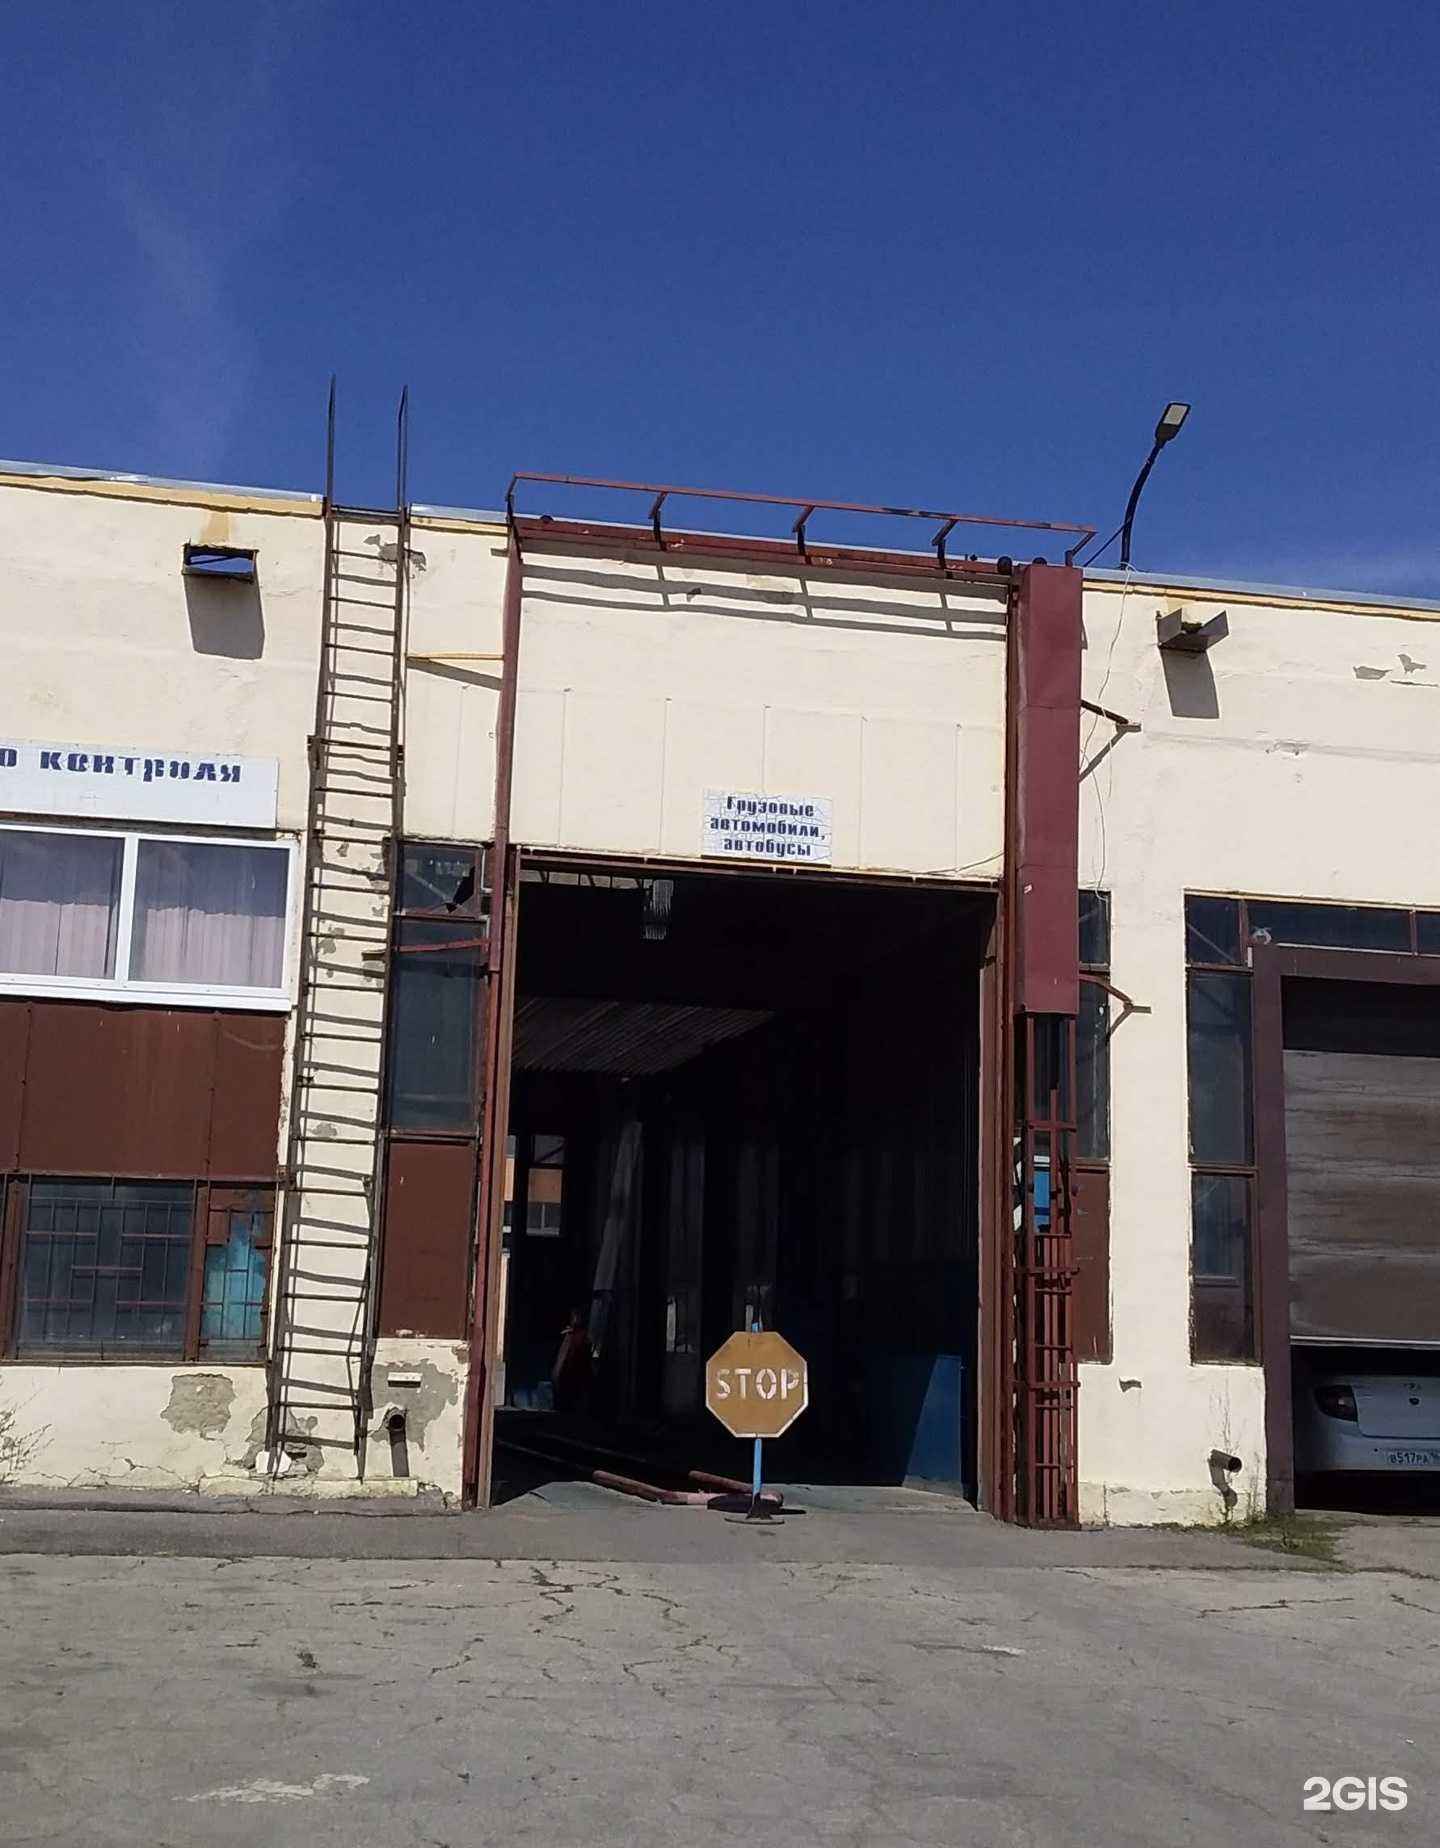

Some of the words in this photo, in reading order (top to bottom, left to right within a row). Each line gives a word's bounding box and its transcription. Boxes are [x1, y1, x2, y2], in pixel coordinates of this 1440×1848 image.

[40, 751, 241, 782] контроля
[726, 796, 814, 817] Грузовые
[710, 817, 826, 840] автомобили,
[723, 838, 811, 857] автобусы
[716, 1368, 800, 1399] STOP
